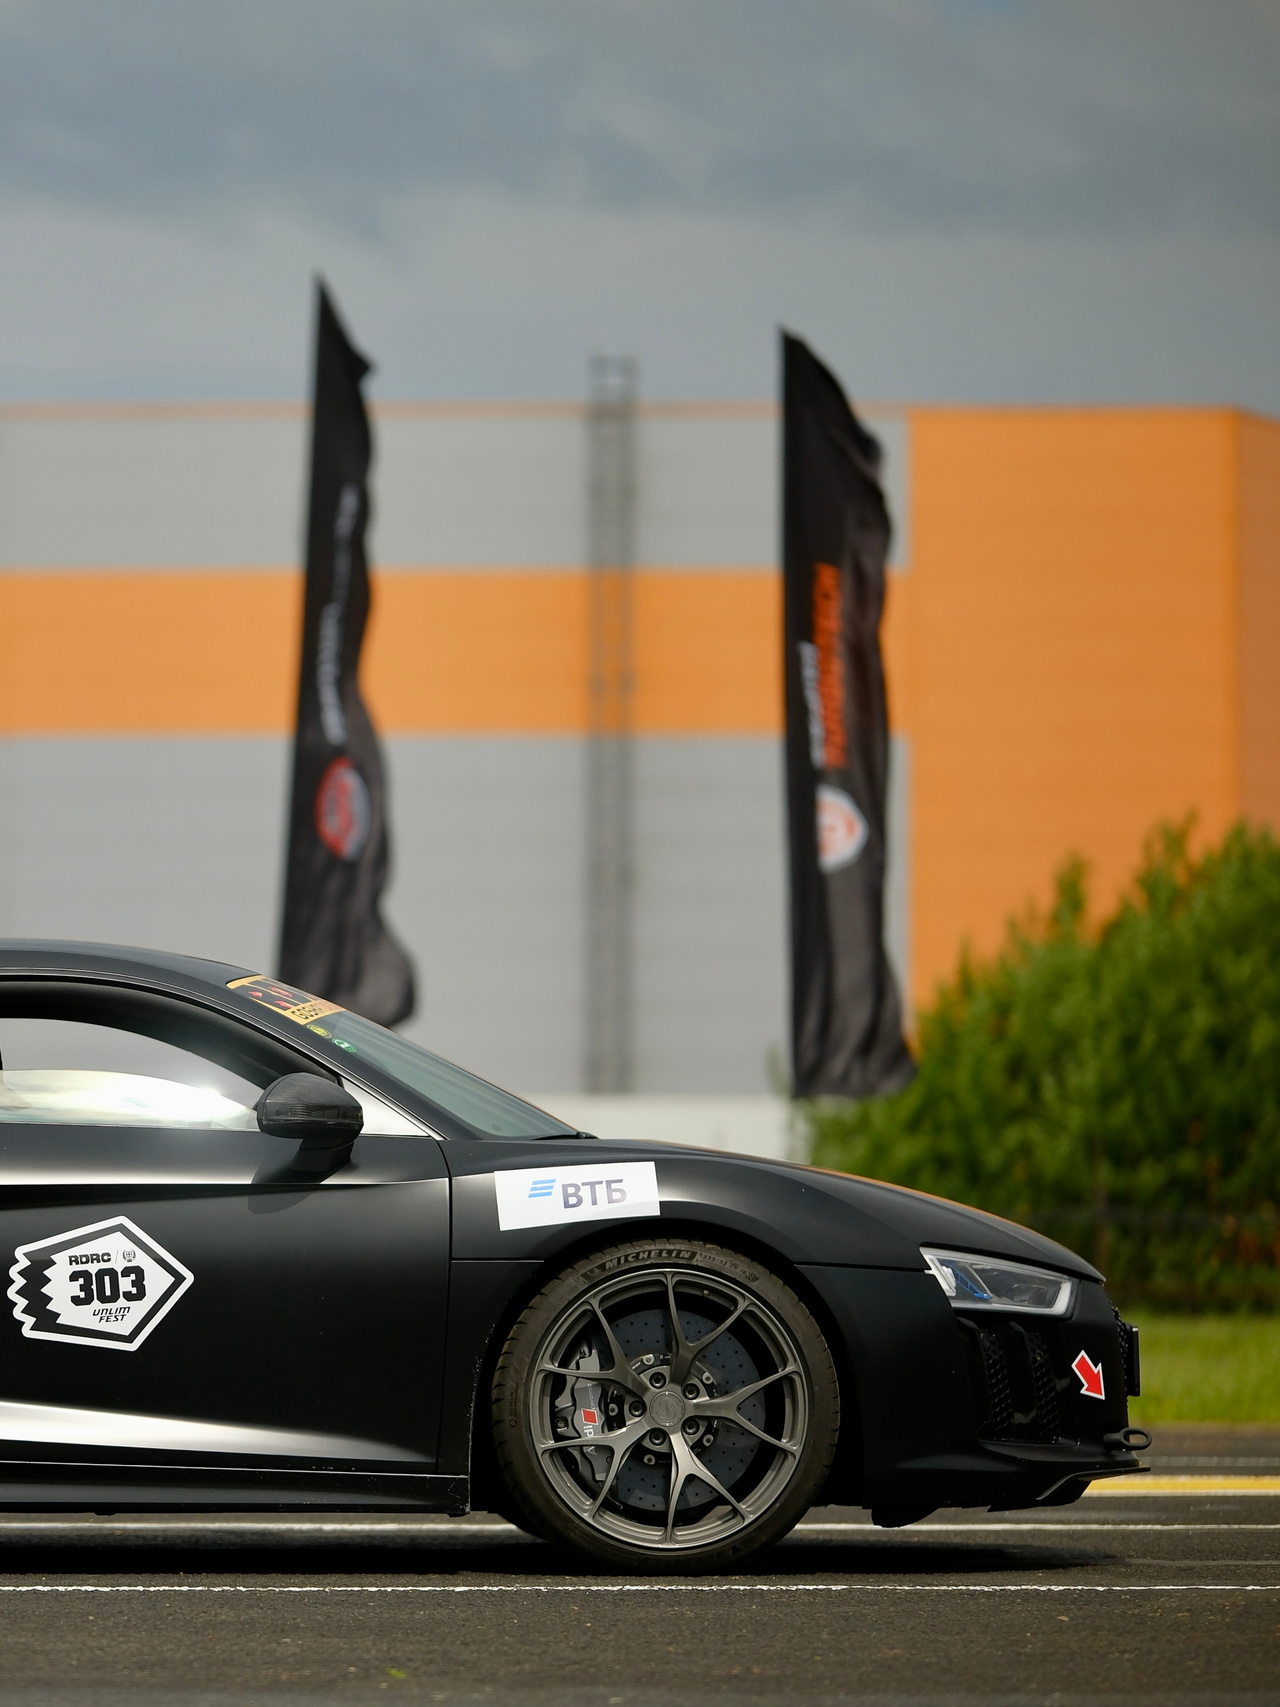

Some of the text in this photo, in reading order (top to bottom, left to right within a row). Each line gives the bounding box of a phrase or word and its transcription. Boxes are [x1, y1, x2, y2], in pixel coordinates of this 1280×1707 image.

[561, 1179, 627, 1209] ВТБ
[68, 1252, 111, 1266] RDRC
[605, 1250, 691, 1269] MICHELIN
[69, 1265, 147, 1306] 303
[92, 1306, 131, 1316] UNLIM
[98, 1314, 128, 1323] FEST
[584, 1425, 597, 1456] Adi
